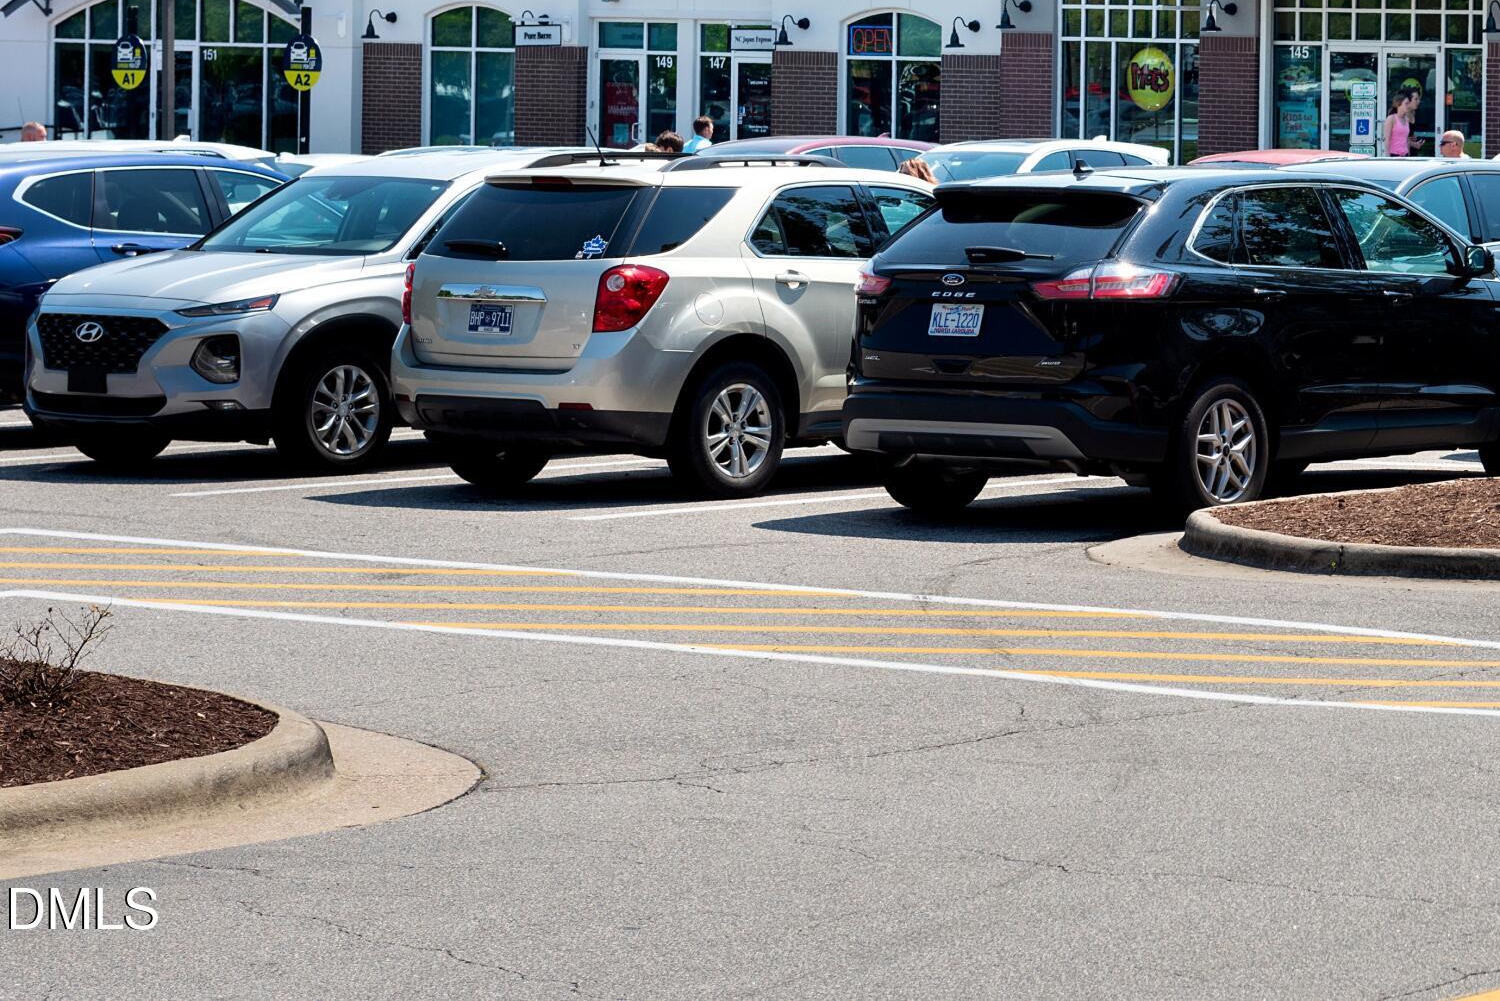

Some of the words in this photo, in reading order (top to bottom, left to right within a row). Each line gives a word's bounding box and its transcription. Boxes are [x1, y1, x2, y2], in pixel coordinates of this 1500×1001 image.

[853, 28, 893, 53] OPEN
[203, 48, 218, 61] 151
[1289, 45, 1309, 59] 145
[655, 56, 673, 68] 149
[708, 57, 726, 69] 147
[122, 72, 135, 85] A1
[294, 73, 311, 87] A2
[491, 311, 511, 327] 9711
[931, 311, 980, 329] KLE-1220
